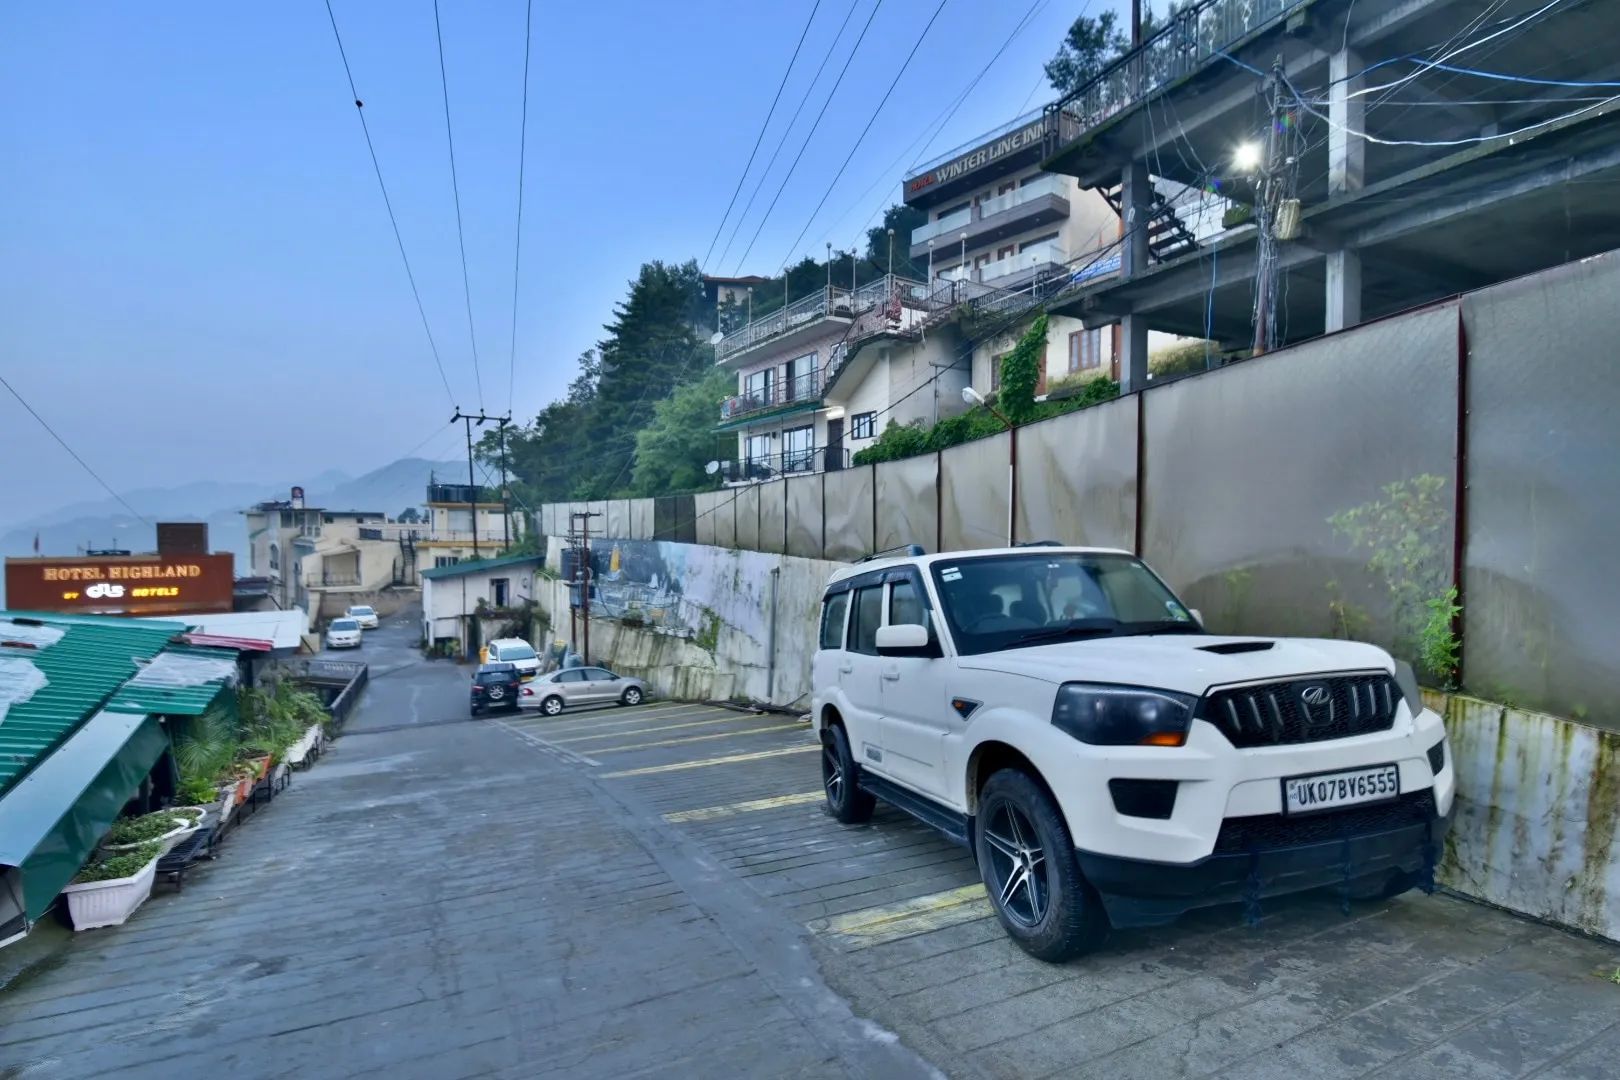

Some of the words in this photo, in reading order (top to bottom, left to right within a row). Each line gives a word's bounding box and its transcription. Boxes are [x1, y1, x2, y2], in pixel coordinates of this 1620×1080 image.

[936, 150, 986, 183] WINTER
[989, 133, 1021, 159] LINE
[1022, 120, 1048, 145] INN
[44, 567, 105, 581] HOTEL
[109, 565, 201, 579] HIGHLAND
[63, 592, 79, 600] BY
[131, 587, 179, 597] HOTELS
